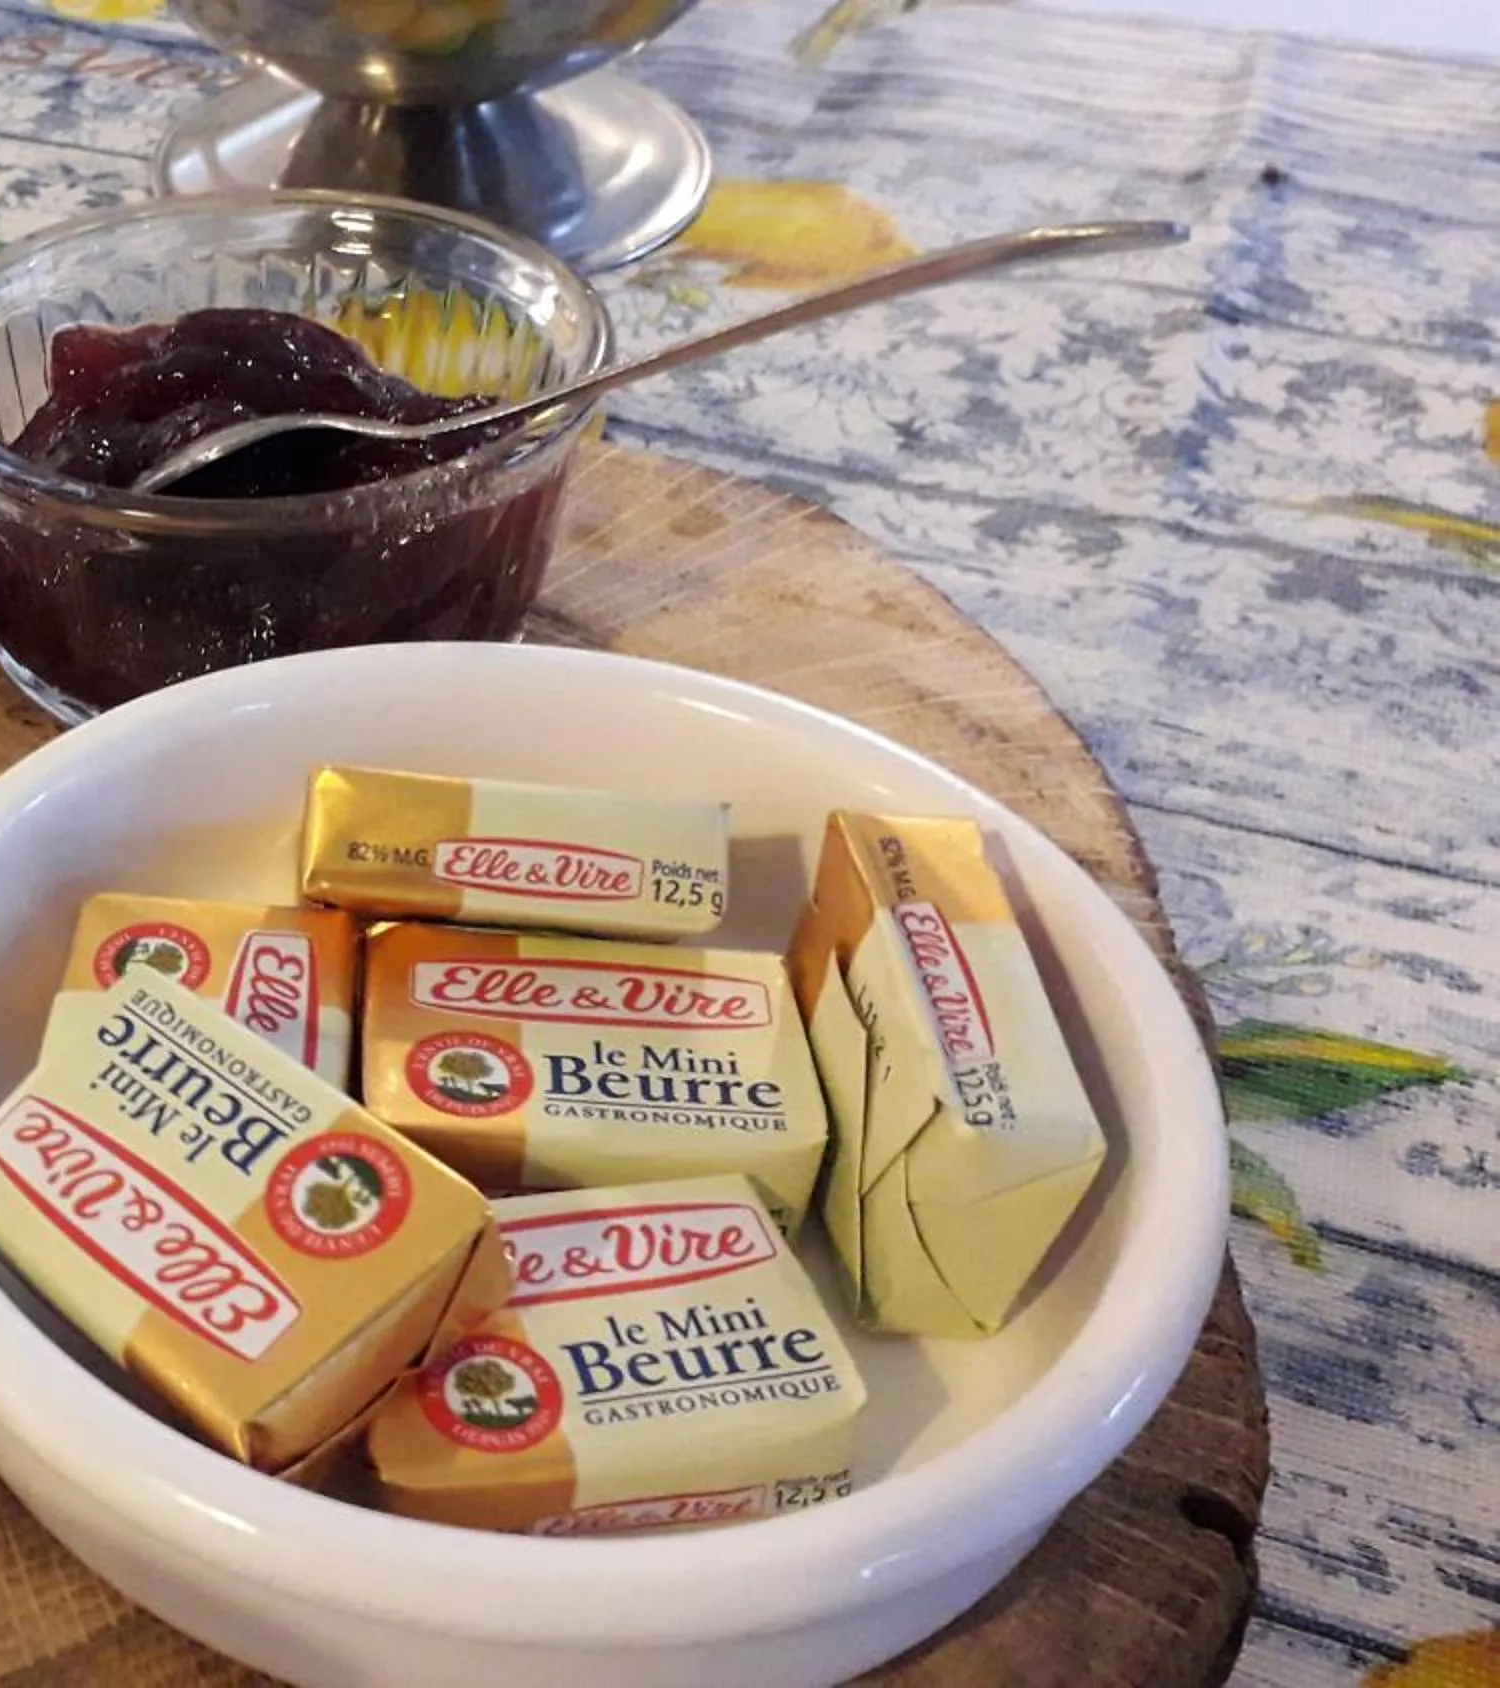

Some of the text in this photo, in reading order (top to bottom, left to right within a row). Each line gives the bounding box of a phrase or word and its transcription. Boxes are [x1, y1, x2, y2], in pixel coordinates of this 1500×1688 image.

[444, 845, 633, 893] Elle & Vire
[651, 858, 692, 879] Poids
[652, 877, 724, 918] 12,5 g
[245, 945, 305, 1034] Elle
[430, 965, 755, 1021] Elle & Vire
[900, 910, 975, 1057] Elle & Vire
[130, 988, 312, 1125] GASTRONOMIQUE
[542, 1053, 783, 1108] Beurre
[593, 1040, 739, 1077] le Mini
[89, 1060, 216, 1166] le Mini
[97, 1013, 293, 1177] Beurre
[543, 1103, 788, 1132] GASTRONOMIQUE
[963, 1108, 995, 1130] g
[13, 1109, 281, 1336] Elle & Vire
[562, 1246, 613, 1278] &
[602, 1223, 755, 1272] Vire
[606, 1297, 768, 1349] le Mini
[559, 1324, 826, 1397] Beurre
[582, 1373, 841, 1426] GASTRONOMIQUE
[775, 1484, 827, 1510] 12,5
